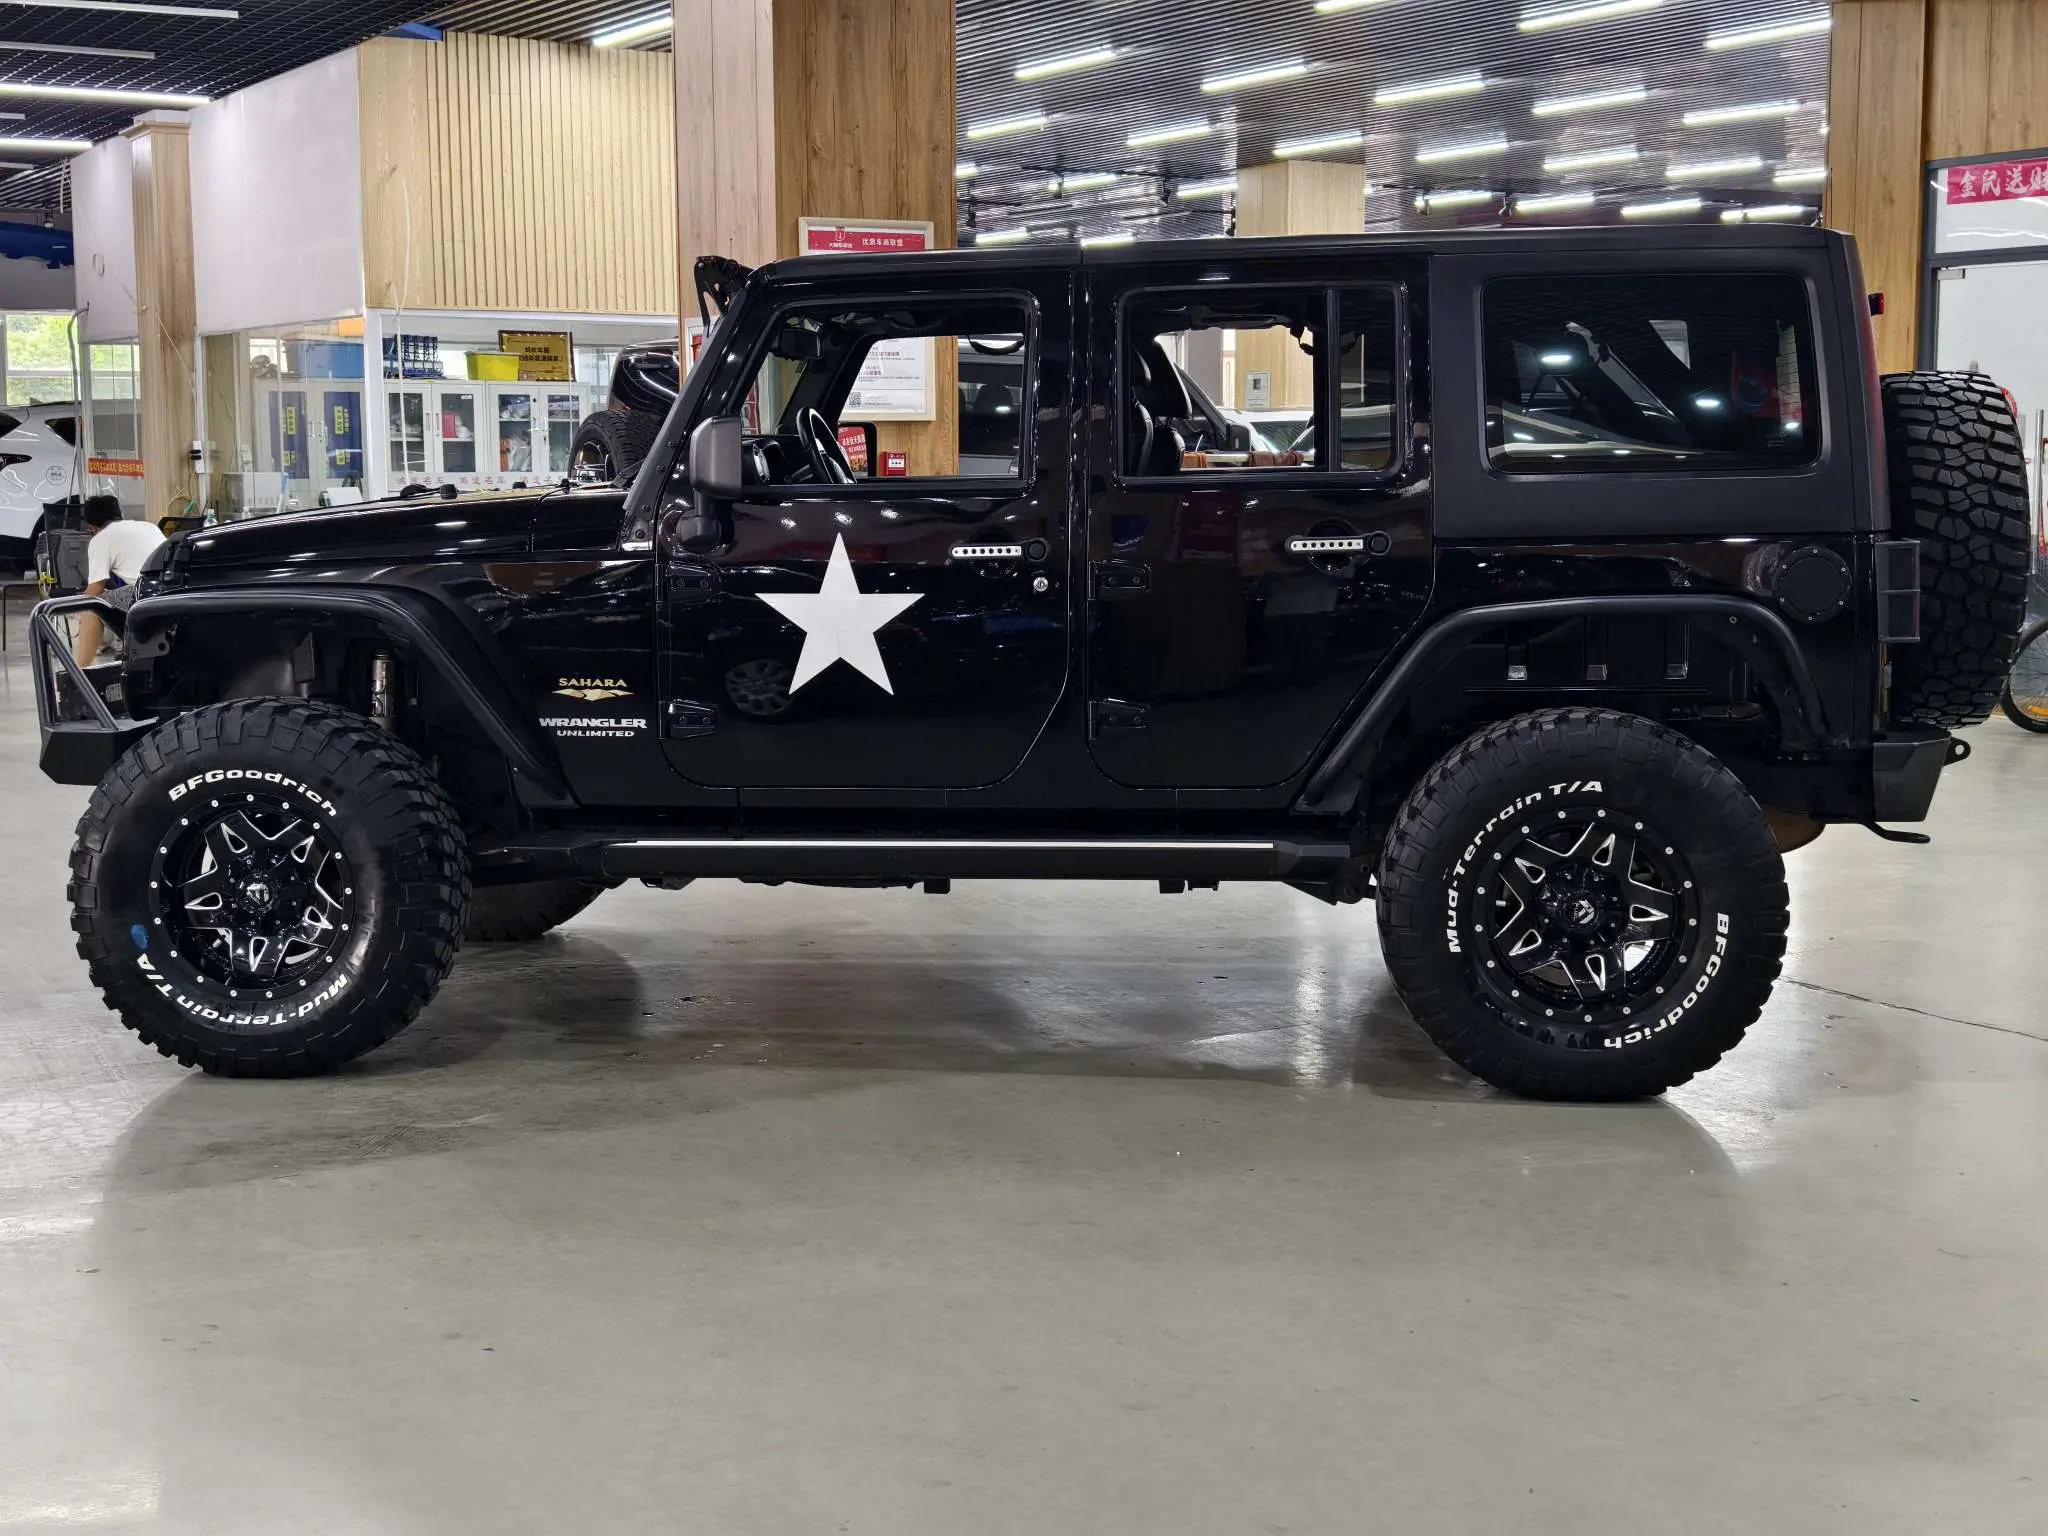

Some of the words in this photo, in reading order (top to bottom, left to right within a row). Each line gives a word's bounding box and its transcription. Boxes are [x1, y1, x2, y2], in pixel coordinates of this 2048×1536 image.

[558, 677, 628, 688] SAHARA
[539, 717, 648, 729] WRANGLER
[168, 769, 337, 817] BFGoodrich
[1447, 791, 1542, 953] Mud-Terrain
[1549, 780, 1603, 796] T/A
[136, 952, 173, 998] T/A
[1604, 912, 1730, 1049] BFGoodrich
[177, 973, 348, 1026] Mud-Terrain
